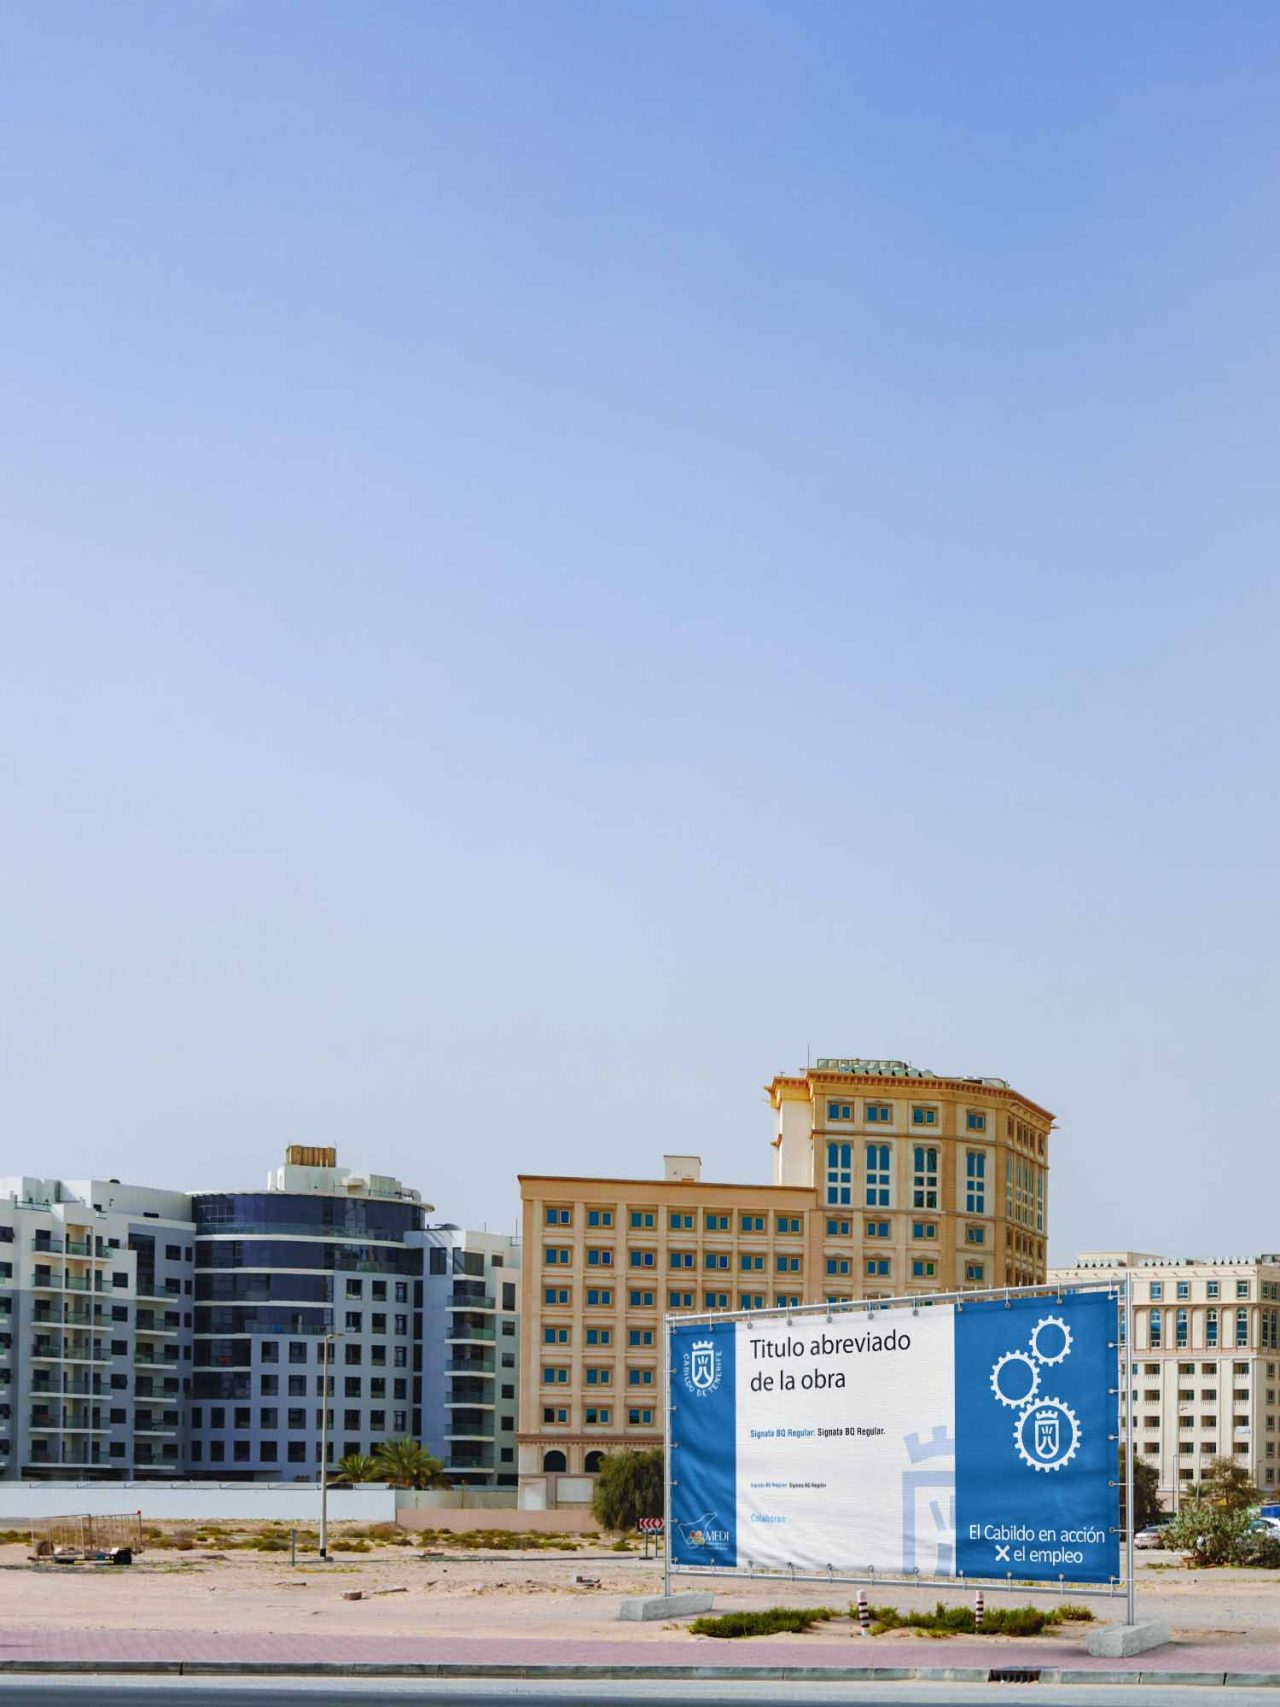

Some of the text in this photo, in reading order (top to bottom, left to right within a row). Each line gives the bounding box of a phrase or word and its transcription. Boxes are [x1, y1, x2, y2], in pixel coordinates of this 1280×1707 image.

[750, 1329, 911, 1359] Titulo abreviado
[683, 1353, 695, 1392] CABILDO
[696, 1389, 707, 1397] DE
[751, 1368, 846, 1392] de la obra
[750, 1429, 774, 1439] Signata
[776, 1429, 785, 1437] BQ
[817, 1427, 886, 1438] Signata BQ Regular.
[969, 1524, 1105, 1543] El Cabildo en acción
[1013, 1545, 1025, 1561] el
[1030, 1546, 1083, 1566] empleo
